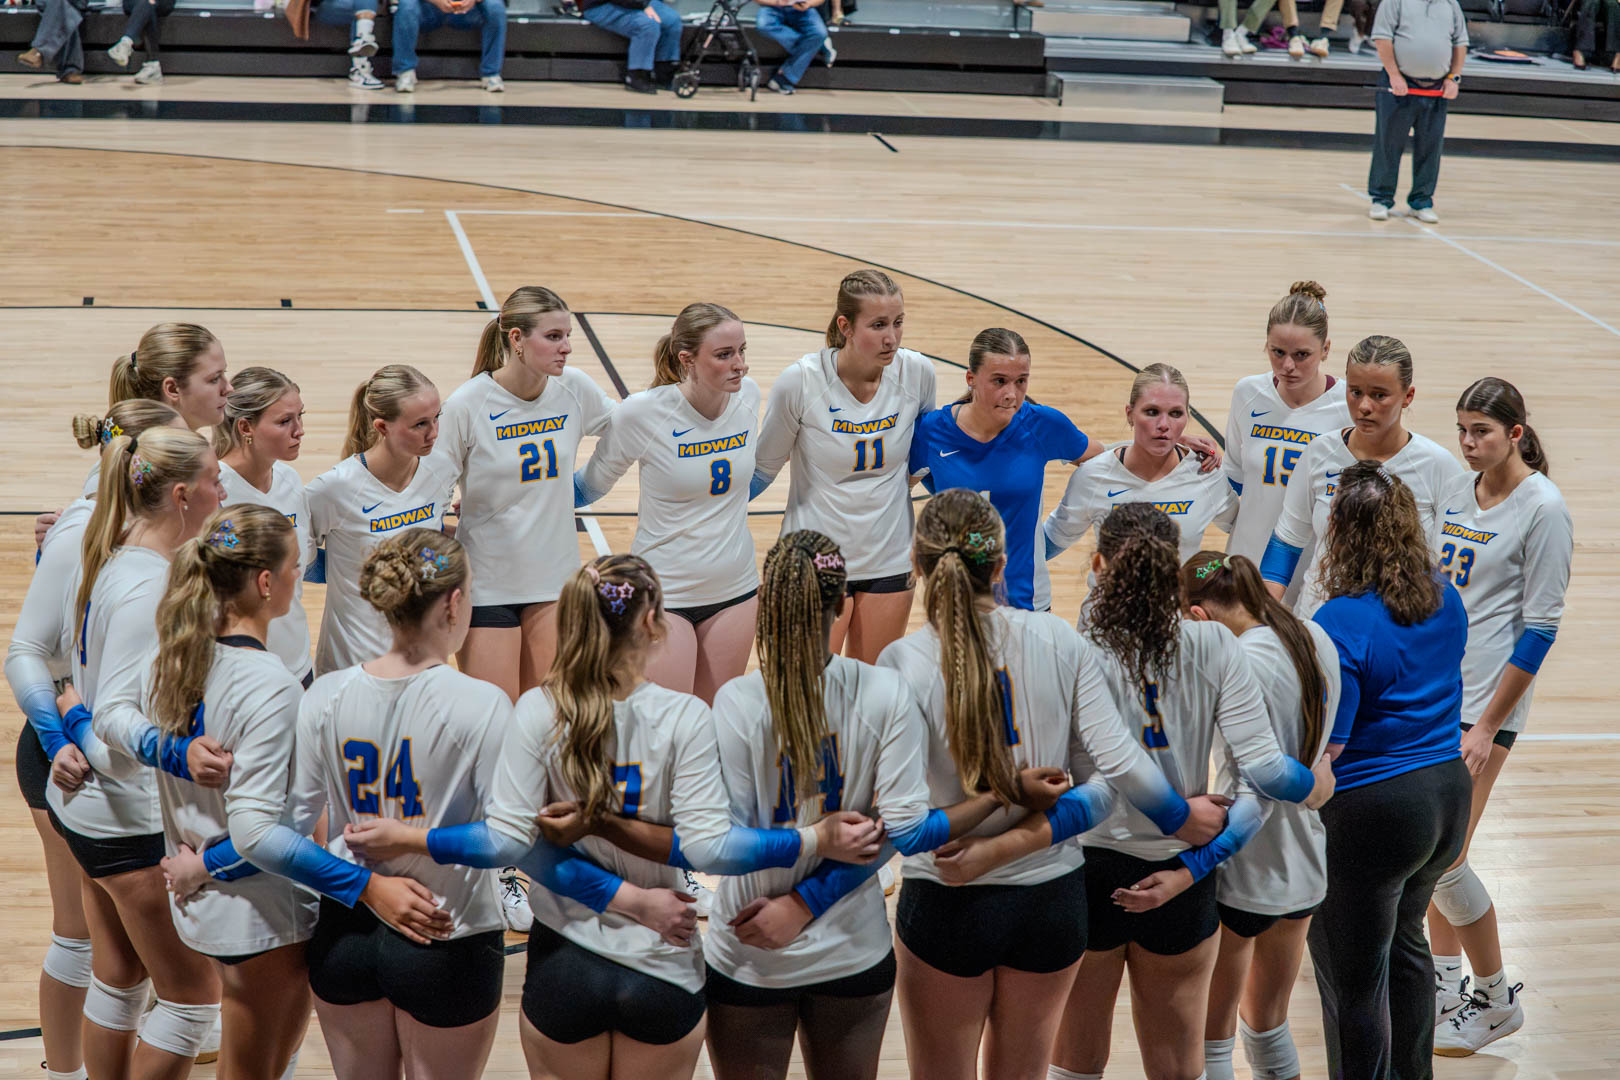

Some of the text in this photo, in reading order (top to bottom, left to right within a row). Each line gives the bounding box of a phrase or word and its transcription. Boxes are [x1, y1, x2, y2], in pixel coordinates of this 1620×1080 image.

[496, 415, 568, 440] MIDWAY
[832, 412, 899, 435] MIDWAY
[518, 438, 560, 484] 21
[678, 430, 748, 458] MIDWAY
[852, 436, 886, 473] 11
[709, 457, 732, 498] 8
[1262, 445, 1304, 488] 15
[370, 502, 435, 533] MIDWAY
[1441, 521, 1498, 545] MIDWAY
[1440, 541, 1476, 589] 23
[341, 737, 426, 820] 24
